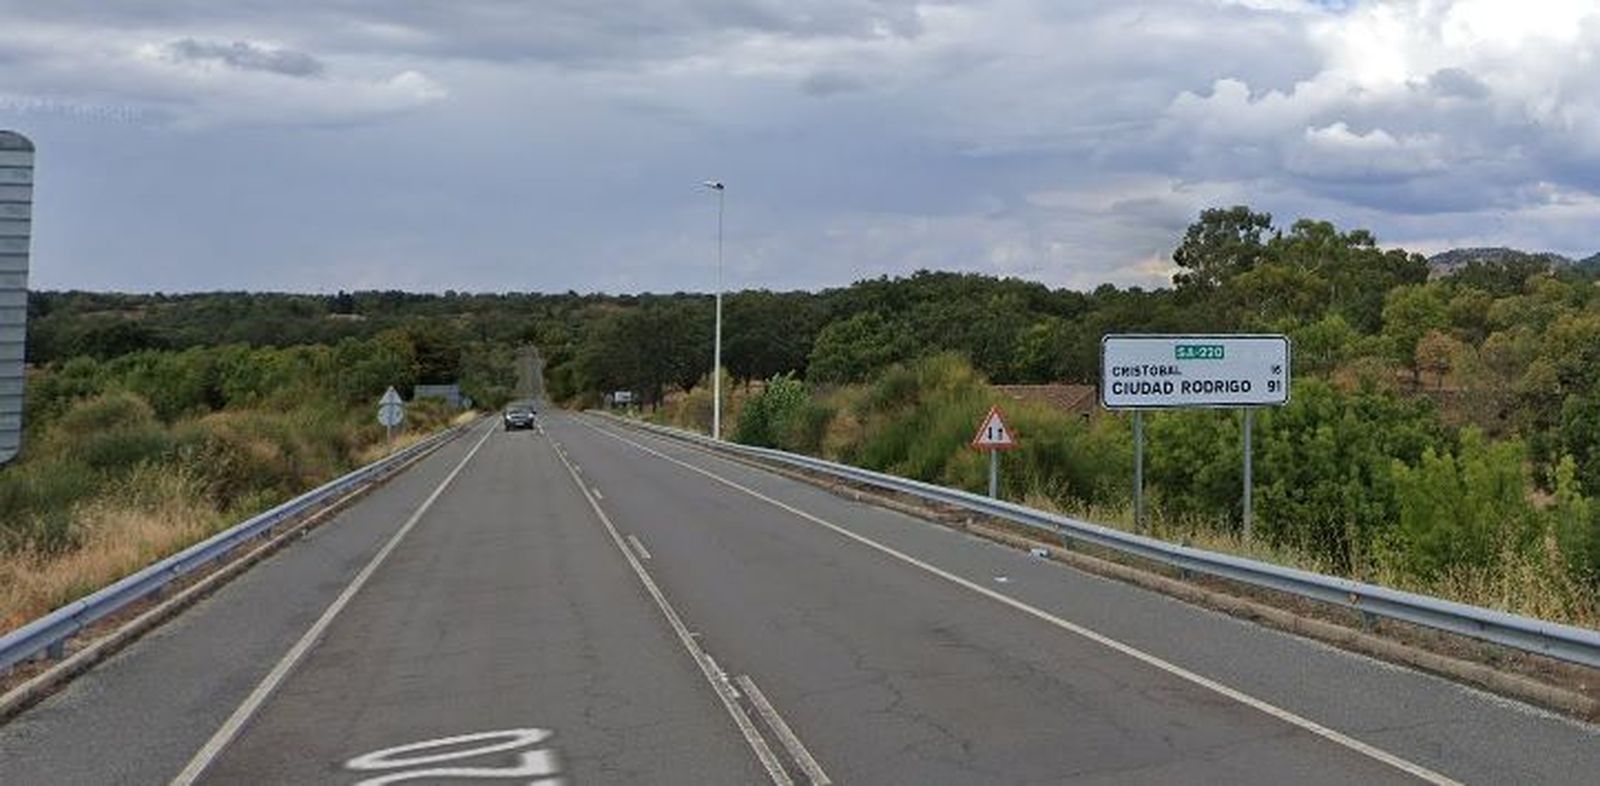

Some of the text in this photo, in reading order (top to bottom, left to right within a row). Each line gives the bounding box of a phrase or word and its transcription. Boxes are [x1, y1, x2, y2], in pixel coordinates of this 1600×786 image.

[1112, 380, 1280, 395] CIUDAD RODRIGO 91
